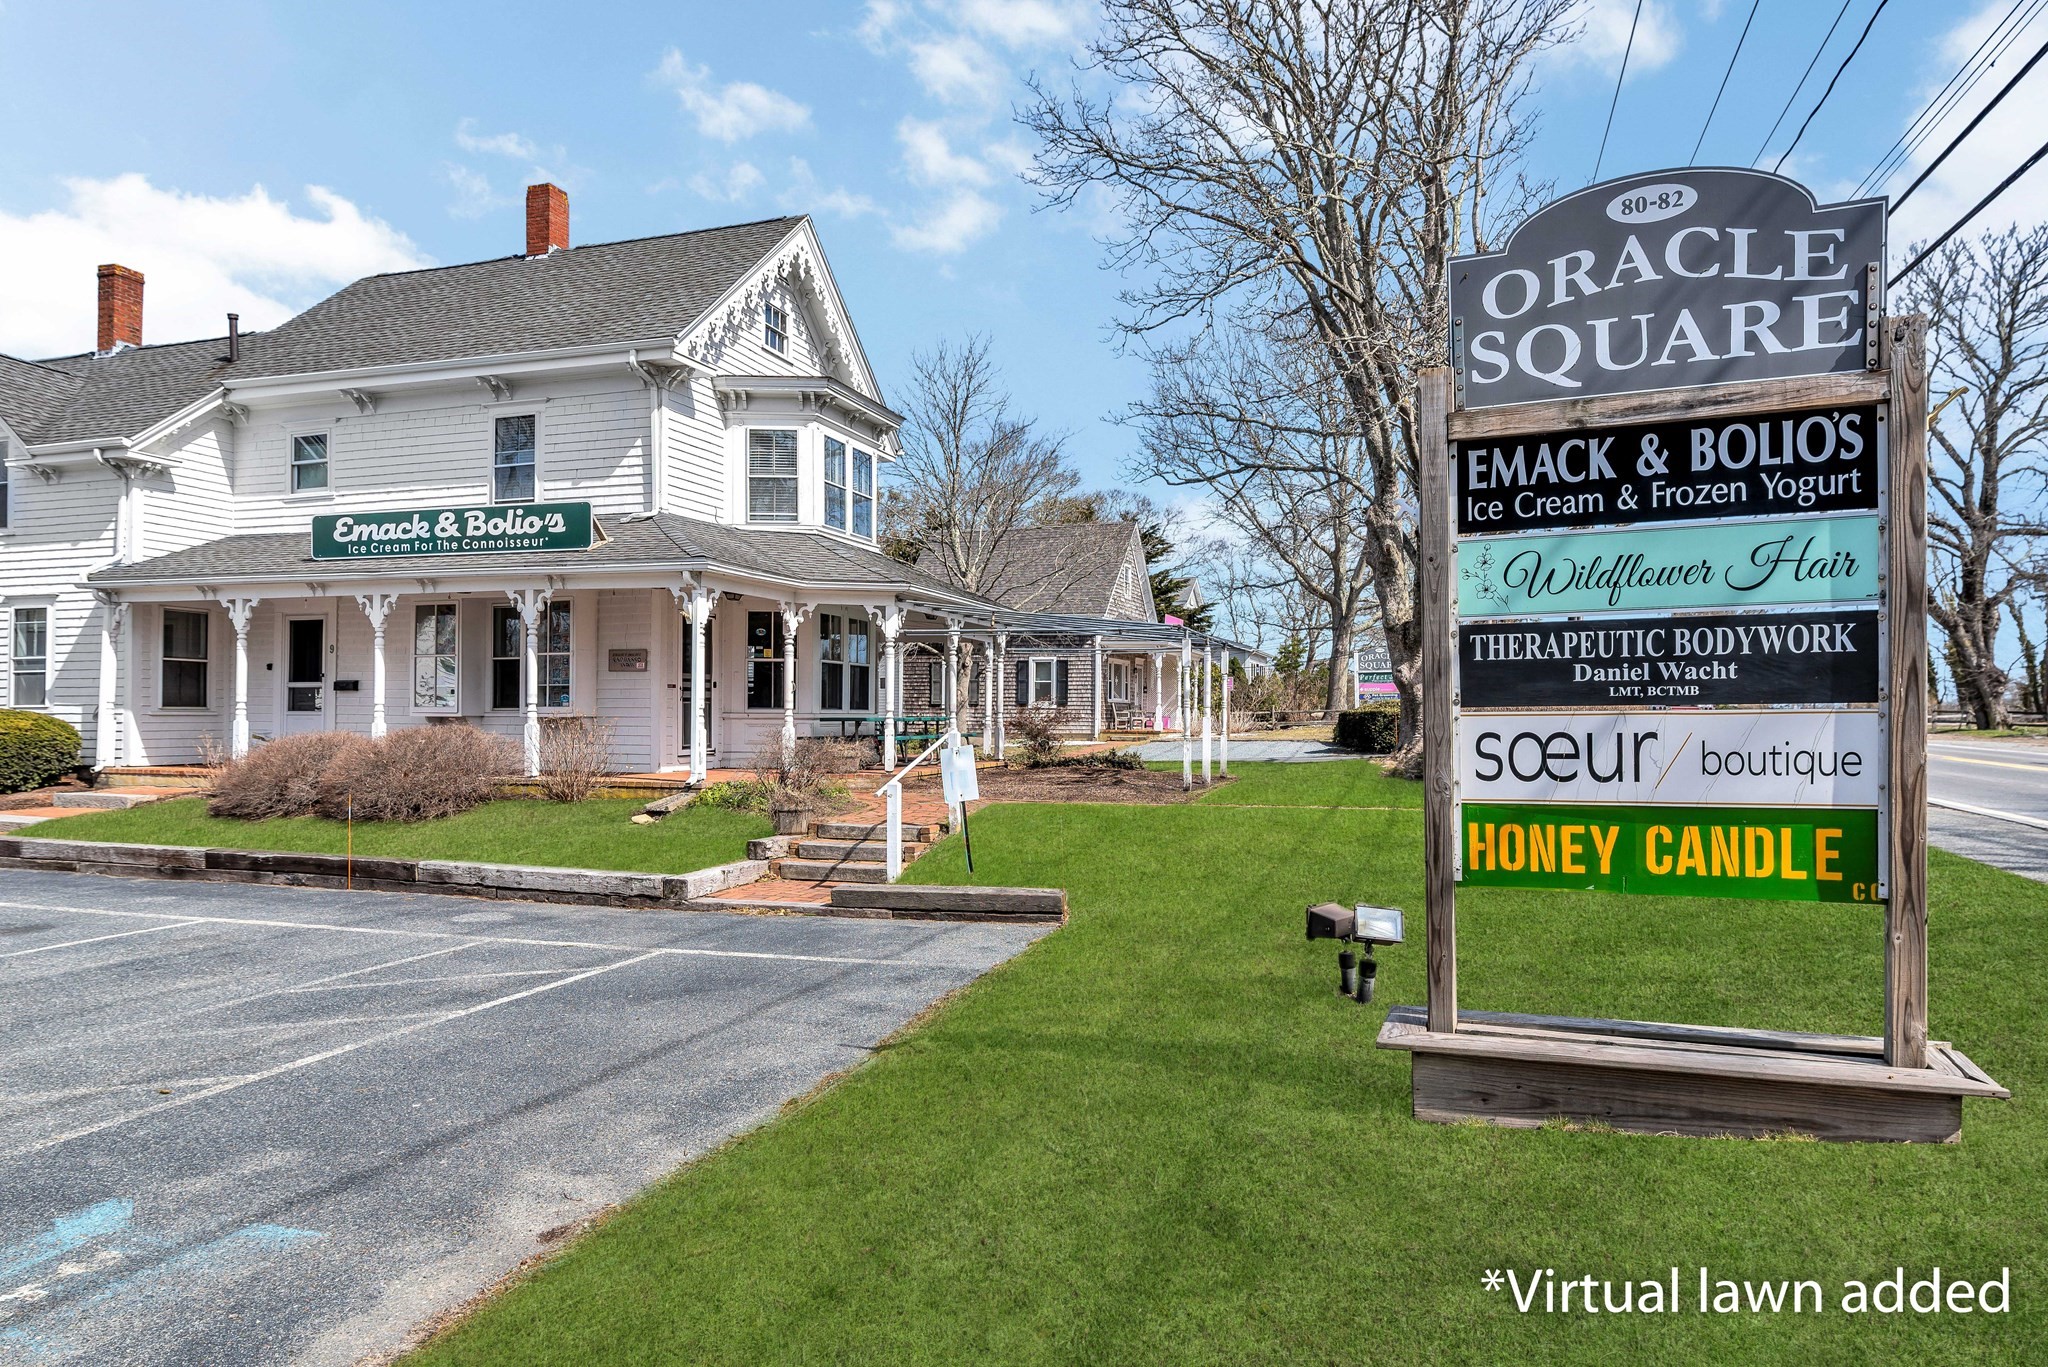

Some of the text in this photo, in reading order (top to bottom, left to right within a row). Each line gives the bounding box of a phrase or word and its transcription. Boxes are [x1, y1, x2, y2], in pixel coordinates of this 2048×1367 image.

[1621, 189, 1684, 216] 80-82
[1482, 227, 1848, 319] ORACLE
[1471, 290, 1863, 388] SQUARE
[1467, 412, 1864, 490] EMACK & BOLIO'S
[1467, 468, 1862, 522] Ice Cream & Frozen Yogurt
[333, 508, 566, 542] Emack & Bolio's
[348, 537, 544, 554] Ice Cream For The Connoisseur
[1503, 535, 1859, 606] Wildflower Hair
[330, 644, 335, 654] 9
[1470, 622, 1857, 661] THERAPEUTIC BODYWORK
[1573, 660, 1738, 682] Daniel Wacht
[1609, 685, 1700, 698] LMT, BCTMB
[1475, 731, 1862, 784] sœur boutique
[1468, 822, 1843, 881] HONEY CANDLE
